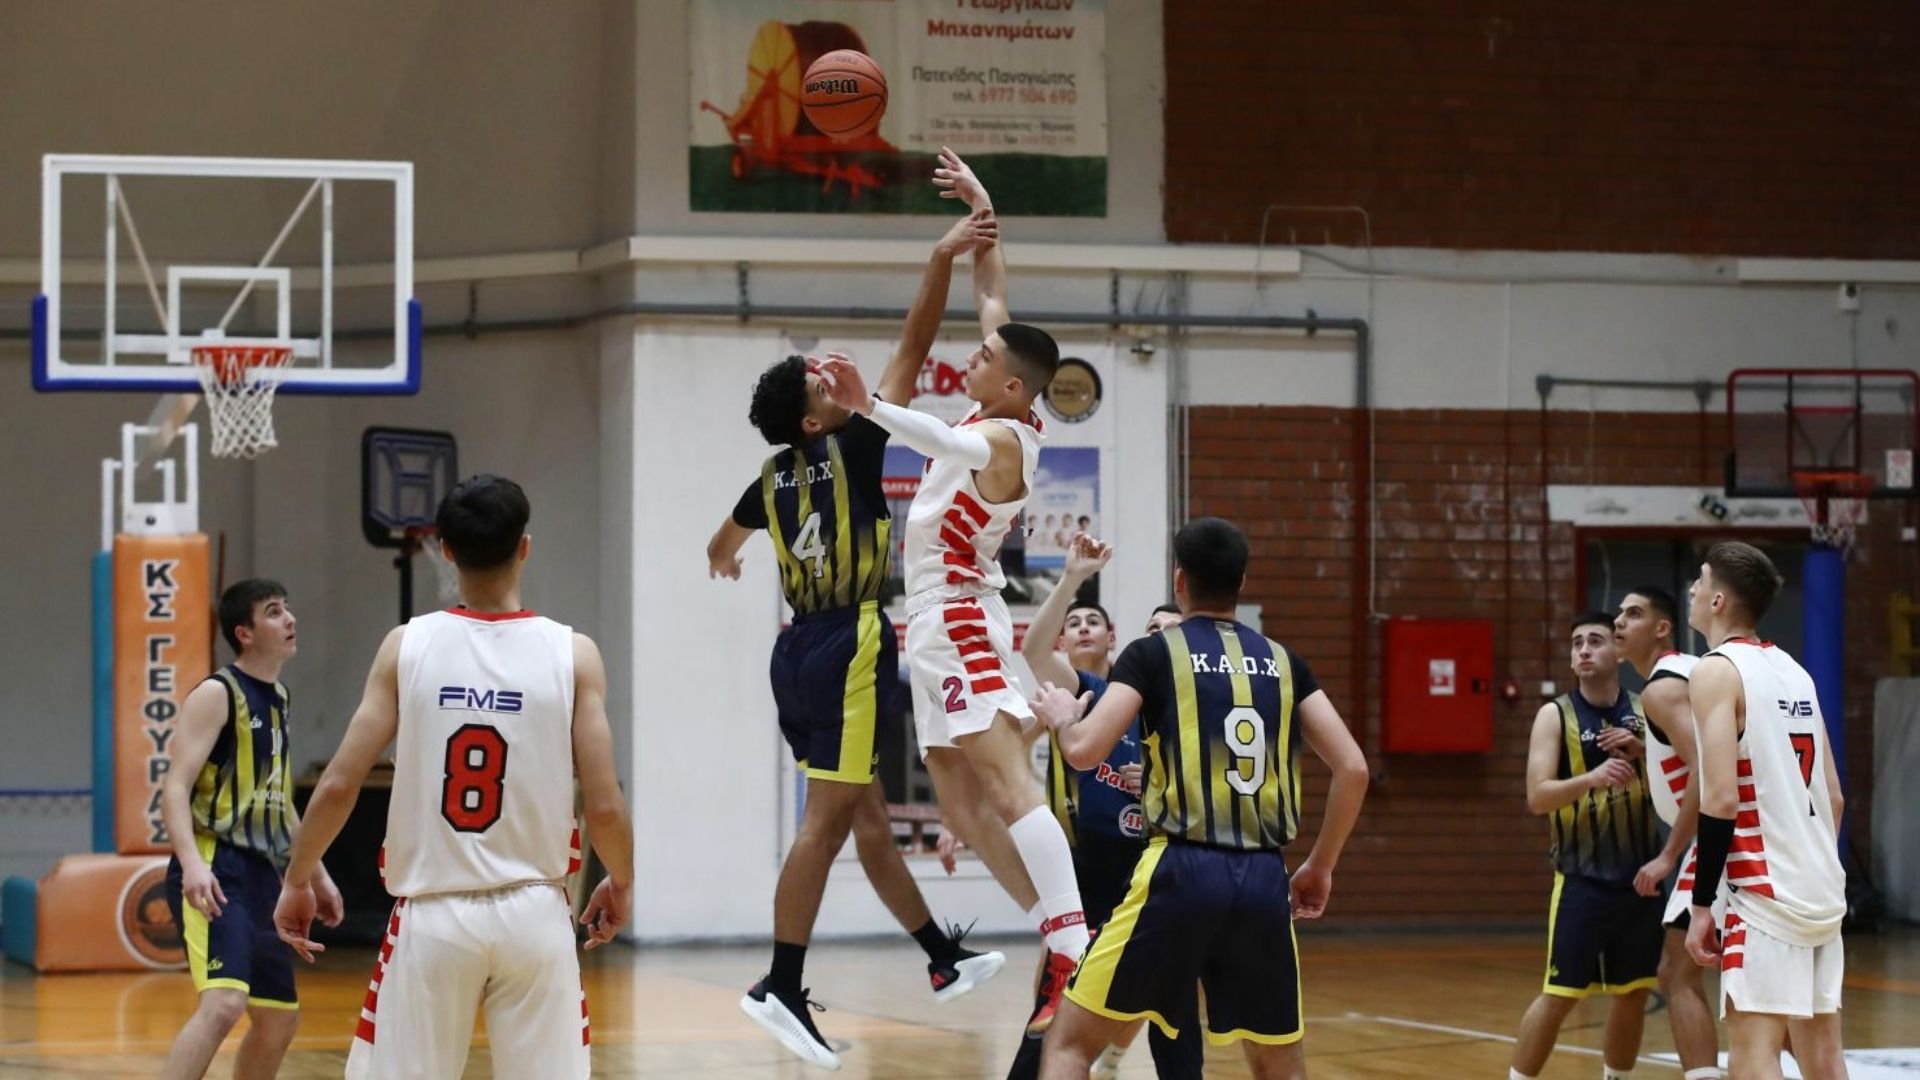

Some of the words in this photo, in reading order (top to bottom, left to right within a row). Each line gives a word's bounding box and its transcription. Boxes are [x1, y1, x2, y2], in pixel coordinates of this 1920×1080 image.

[927, 19, 1075, 42] Μηχανημάτων
[805, 79, 858, 95] Wilson
[791, 512, 827, 579] 4
[144, 561, 177, 619] ΚΣ
[438, 686, 523, 713] FMS
[942, 675, 967, 713] 2
[1778, 699, 1813, 717] FMS
[1223, 705, 1265, 797] 9
[1788, 732, 1816, 816] 7
[441, 723, 508, 833] 8
